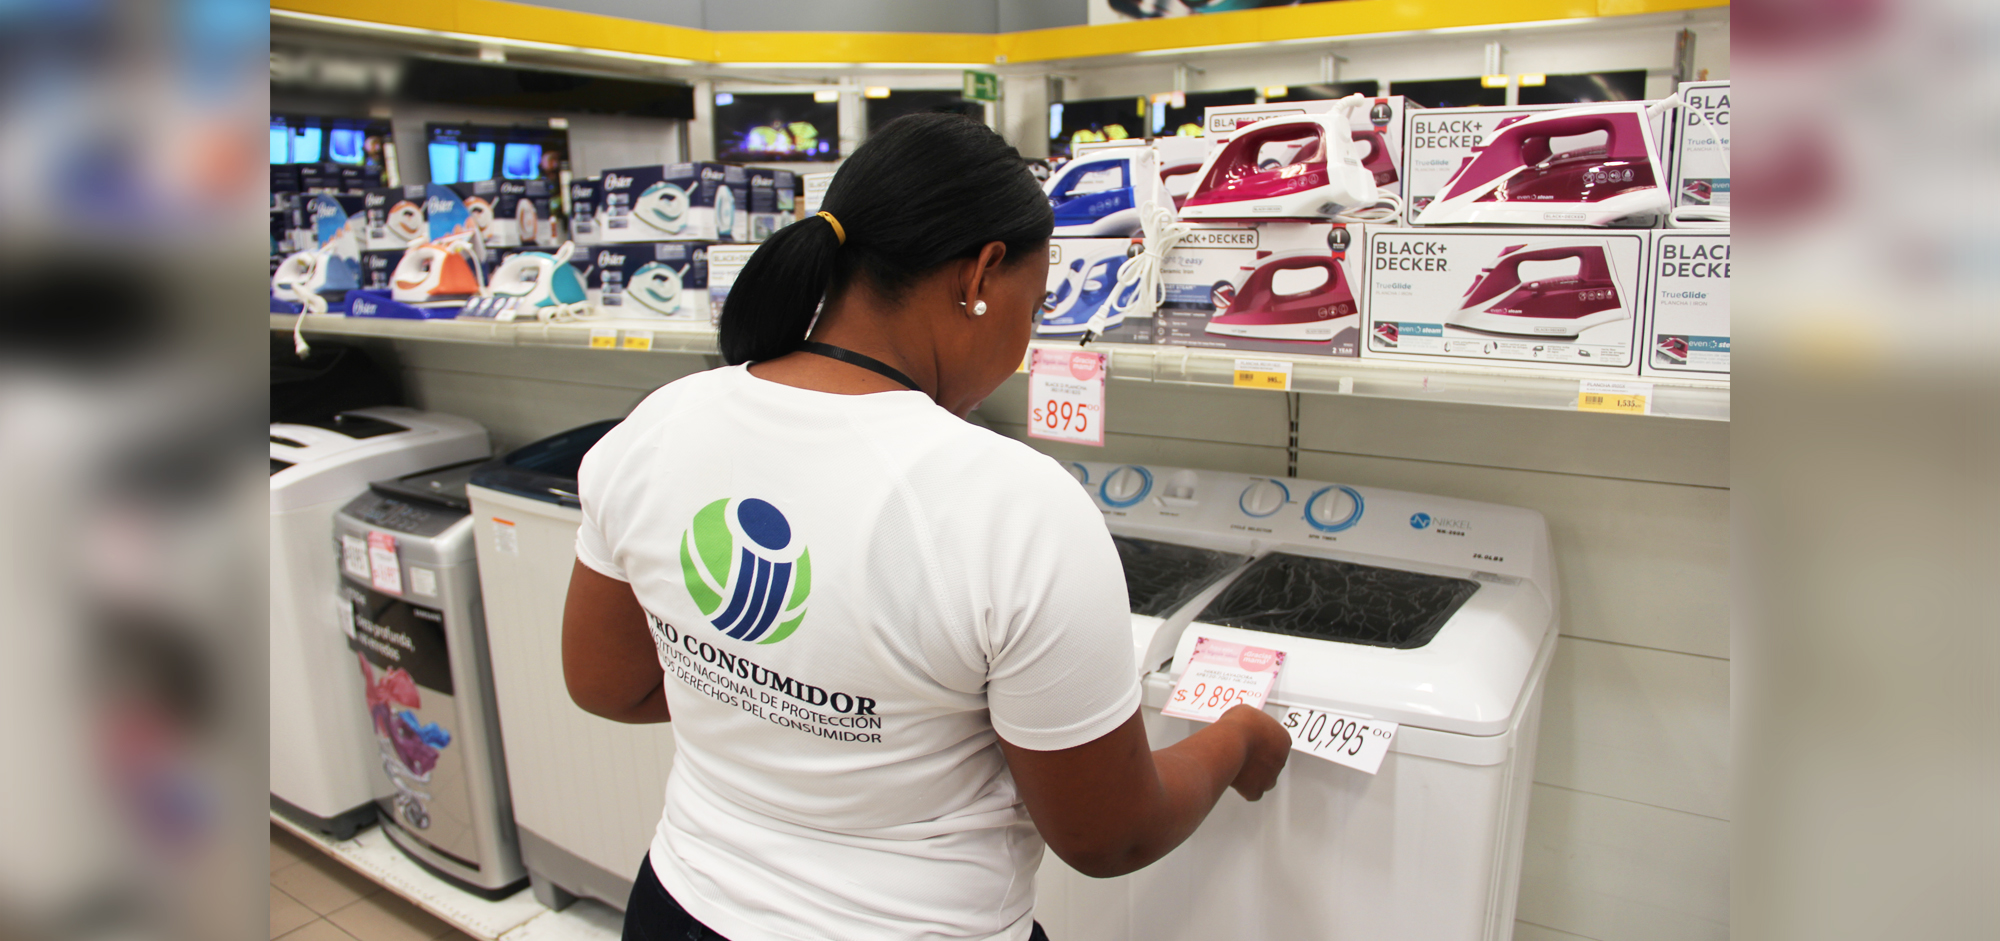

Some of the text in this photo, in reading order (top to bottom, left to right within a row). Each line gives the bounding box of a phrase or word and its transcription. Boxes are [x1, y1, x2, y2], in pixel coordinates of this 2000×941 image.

[1416, 120, 1482, 134] BLACK+
[1415, 135, 1483, 148] DECKER
[604, 172, 634, 191] Oster
[1376, 241, 1448, 256] BLACK+
[598, 250, 626, 268] Oster
[1376, 257, 1448, 272] DECKER
[1661, 290, 1707, 299] TrueGlide
[352, 298, 378, 316] Oster
[1688, 340, 1708, 348] even
[684, 634, 877, 716] CONSUMIDOR
[694, 661, 758, 700] NACIONAL
[760, 692, 778, 709] DE
[782, 700, 882, 729] PROTECCIÓN
[676, 666, 738, 706] DERECHOS
[742, 700, 766, 720] DEL
[769, 712, 882, 743] CONSUMIDOR
[1284, 710, 1392, 756] $10,995 00
